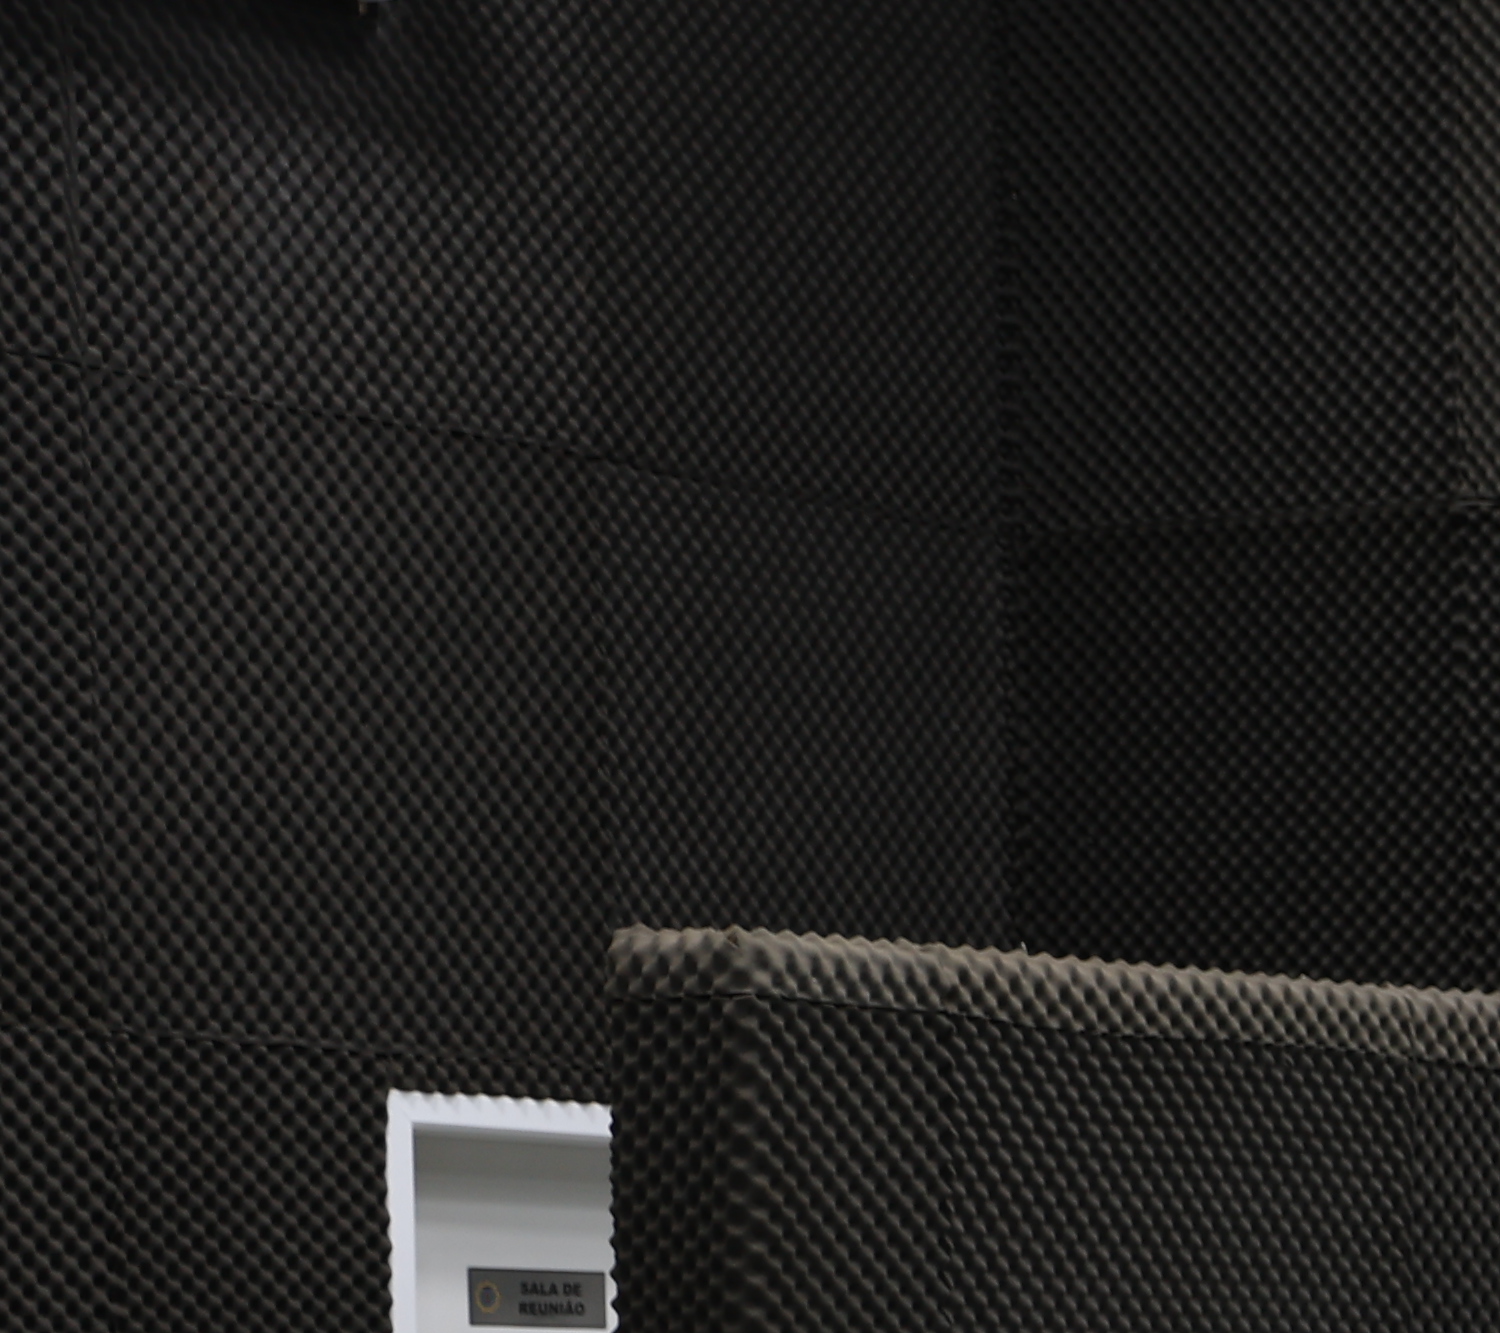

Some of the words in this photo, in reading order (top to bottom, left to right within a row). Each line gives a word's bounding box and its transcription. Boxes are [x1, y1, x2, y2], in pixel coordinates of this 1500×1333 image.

[520, 1281, 559, 1297] SALA
[562, 1282, 582, 1298] DE
[518, 1299, 586, 1317] REUNIÃO
